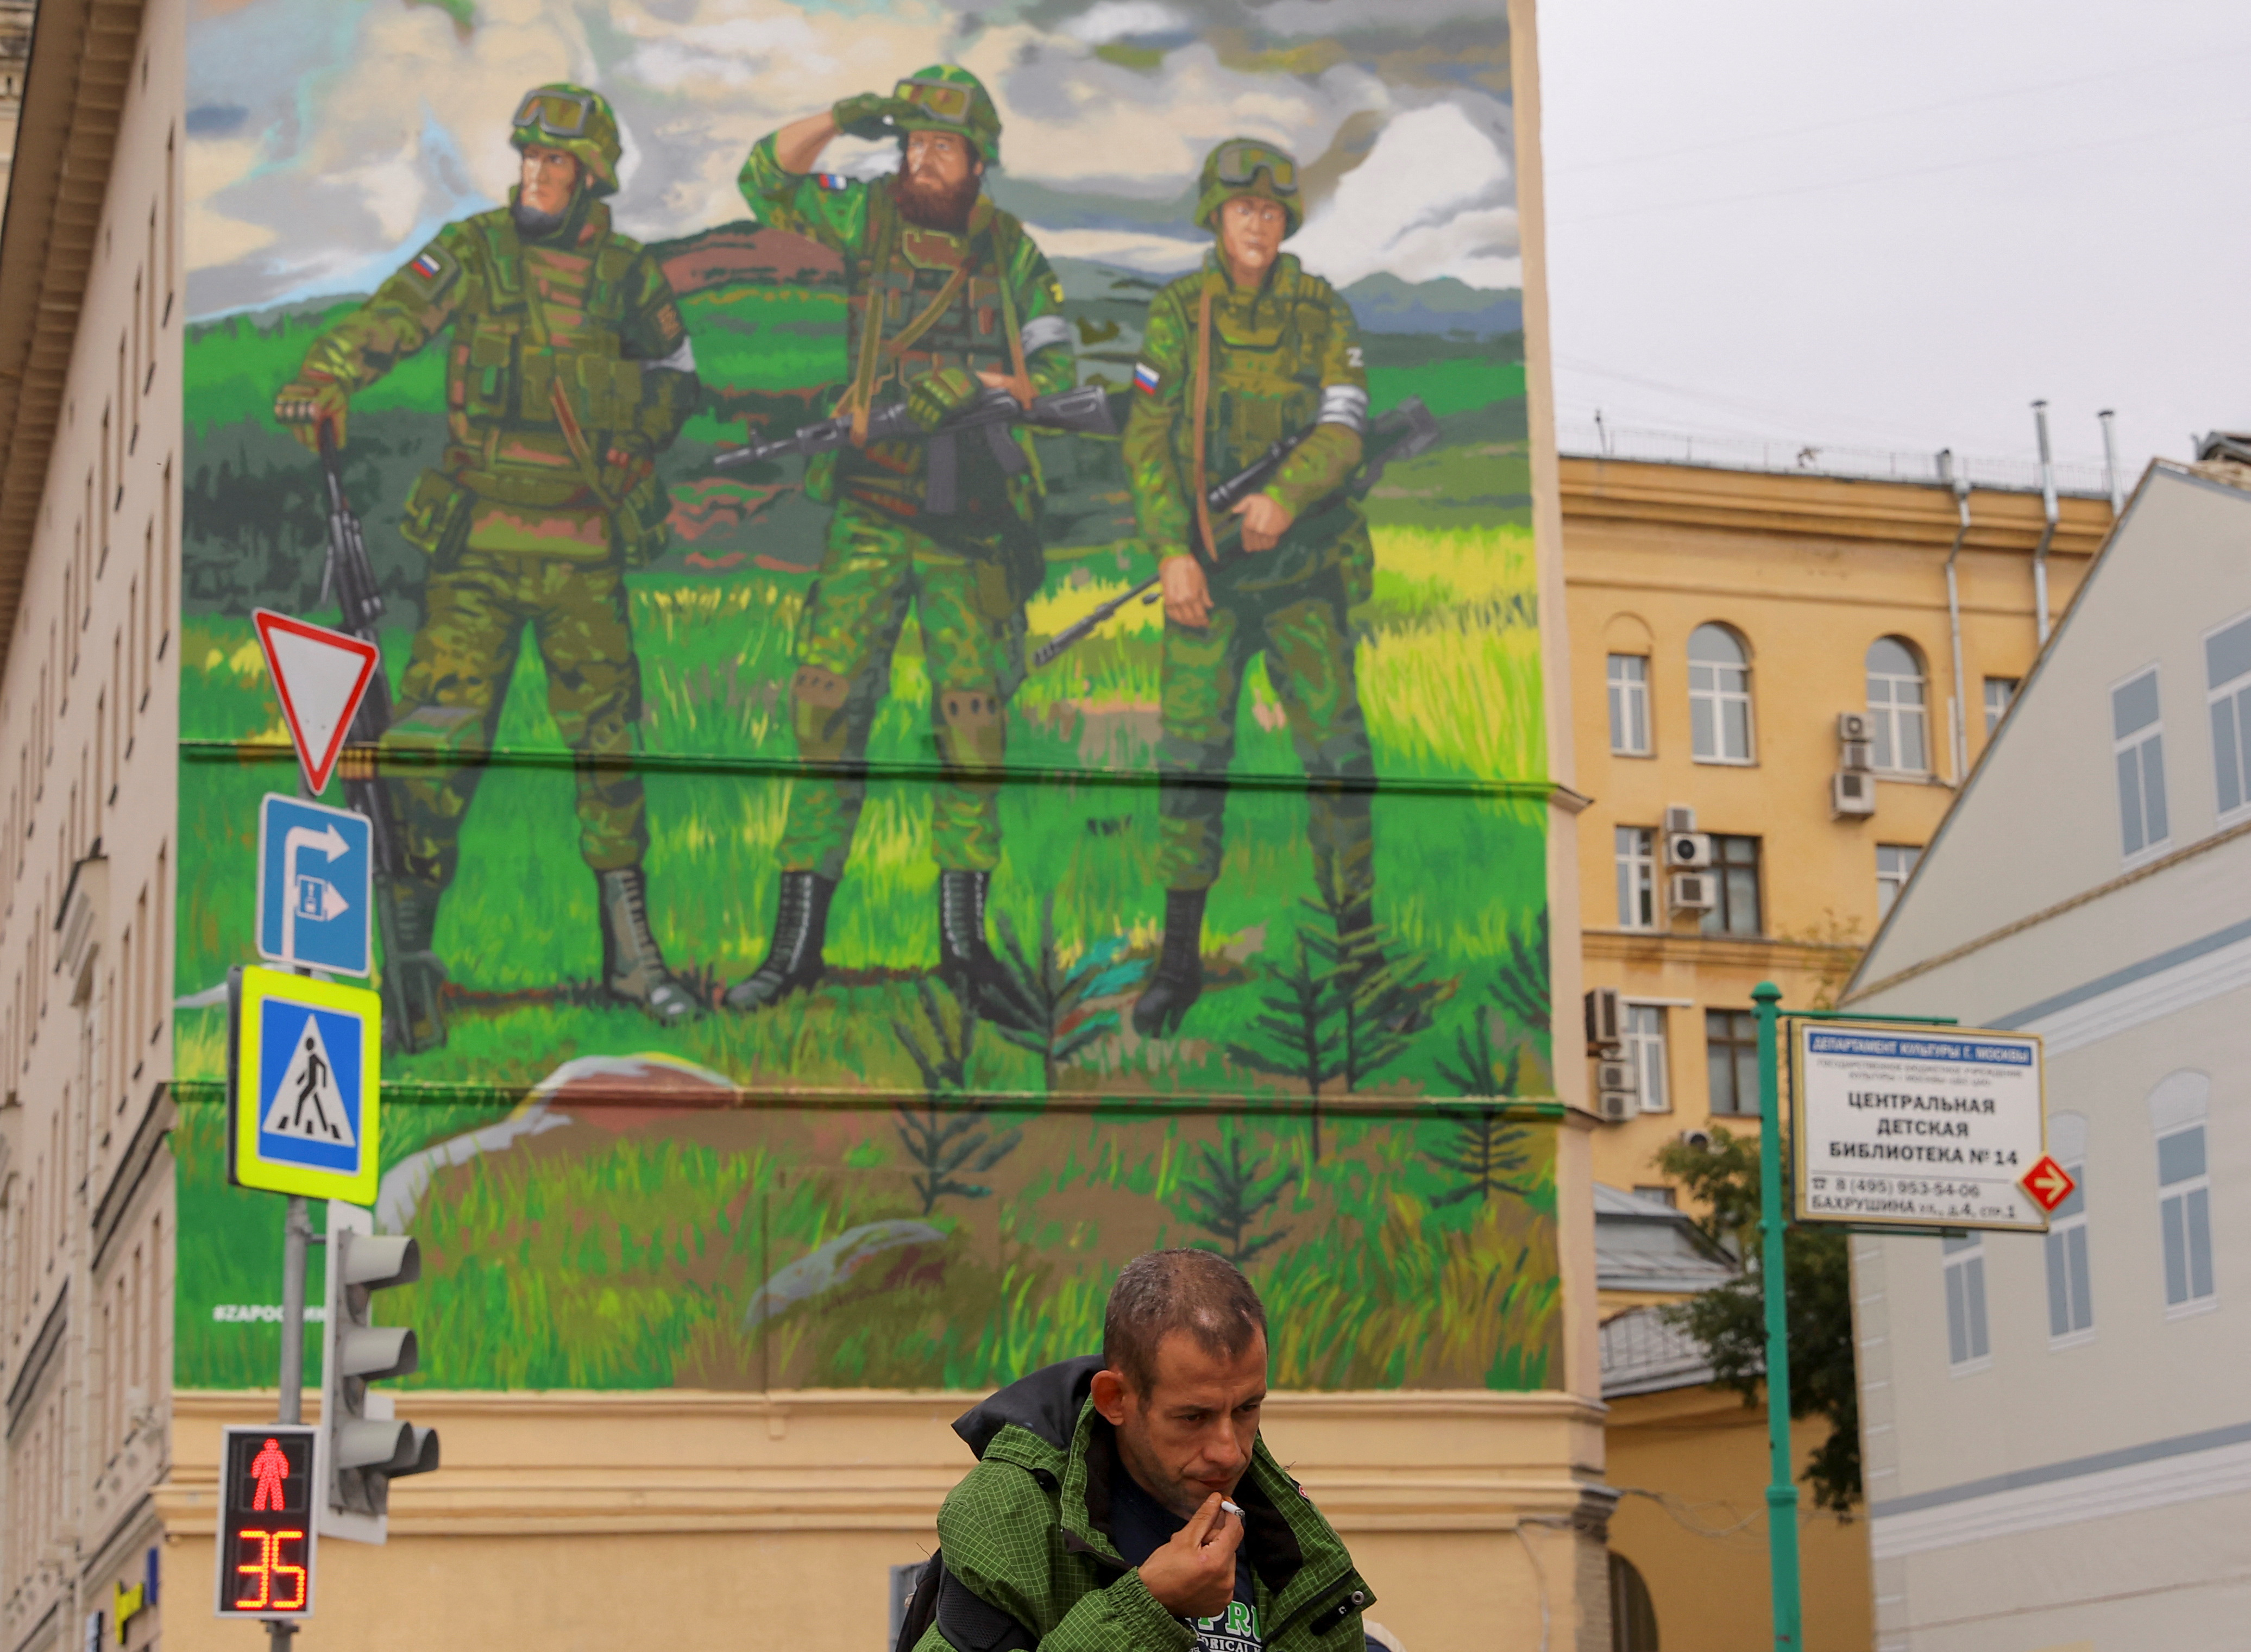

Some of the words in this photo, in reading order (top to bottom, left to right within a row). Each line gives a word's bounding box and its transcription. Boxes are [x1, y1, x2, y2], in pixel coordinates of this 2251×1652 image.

[1812, 1036, 1897, 1054] ДЕПАРТАМЕНТ
[1900, 1042, 1961, 1059] КУЛЬТУРЫ
[1975, 1046, 2030, 1063] МОСКВЫ
[1848, 1092, 1995, 1113] ЦЕНТРАЛЬНАЯ
[1877, 1118, 1969, 1136] ДЕТСКАЯ
[1829, 1141, 1964, 1163] БИБЛИОТЕКА
[1970, 1148, 1989, 1164] №
[1995, 1151, 2018, 1165] 14
[1836, 1178, 1846, 1191] 8
[1850, 1178, 1894, 1195] (495)
[1897, 1180, 1980, 1198] 953-54-06
[1812, 1195, 1915, 1213] БАХРУШИНА
[236, 1530, 305, 1609] 35
